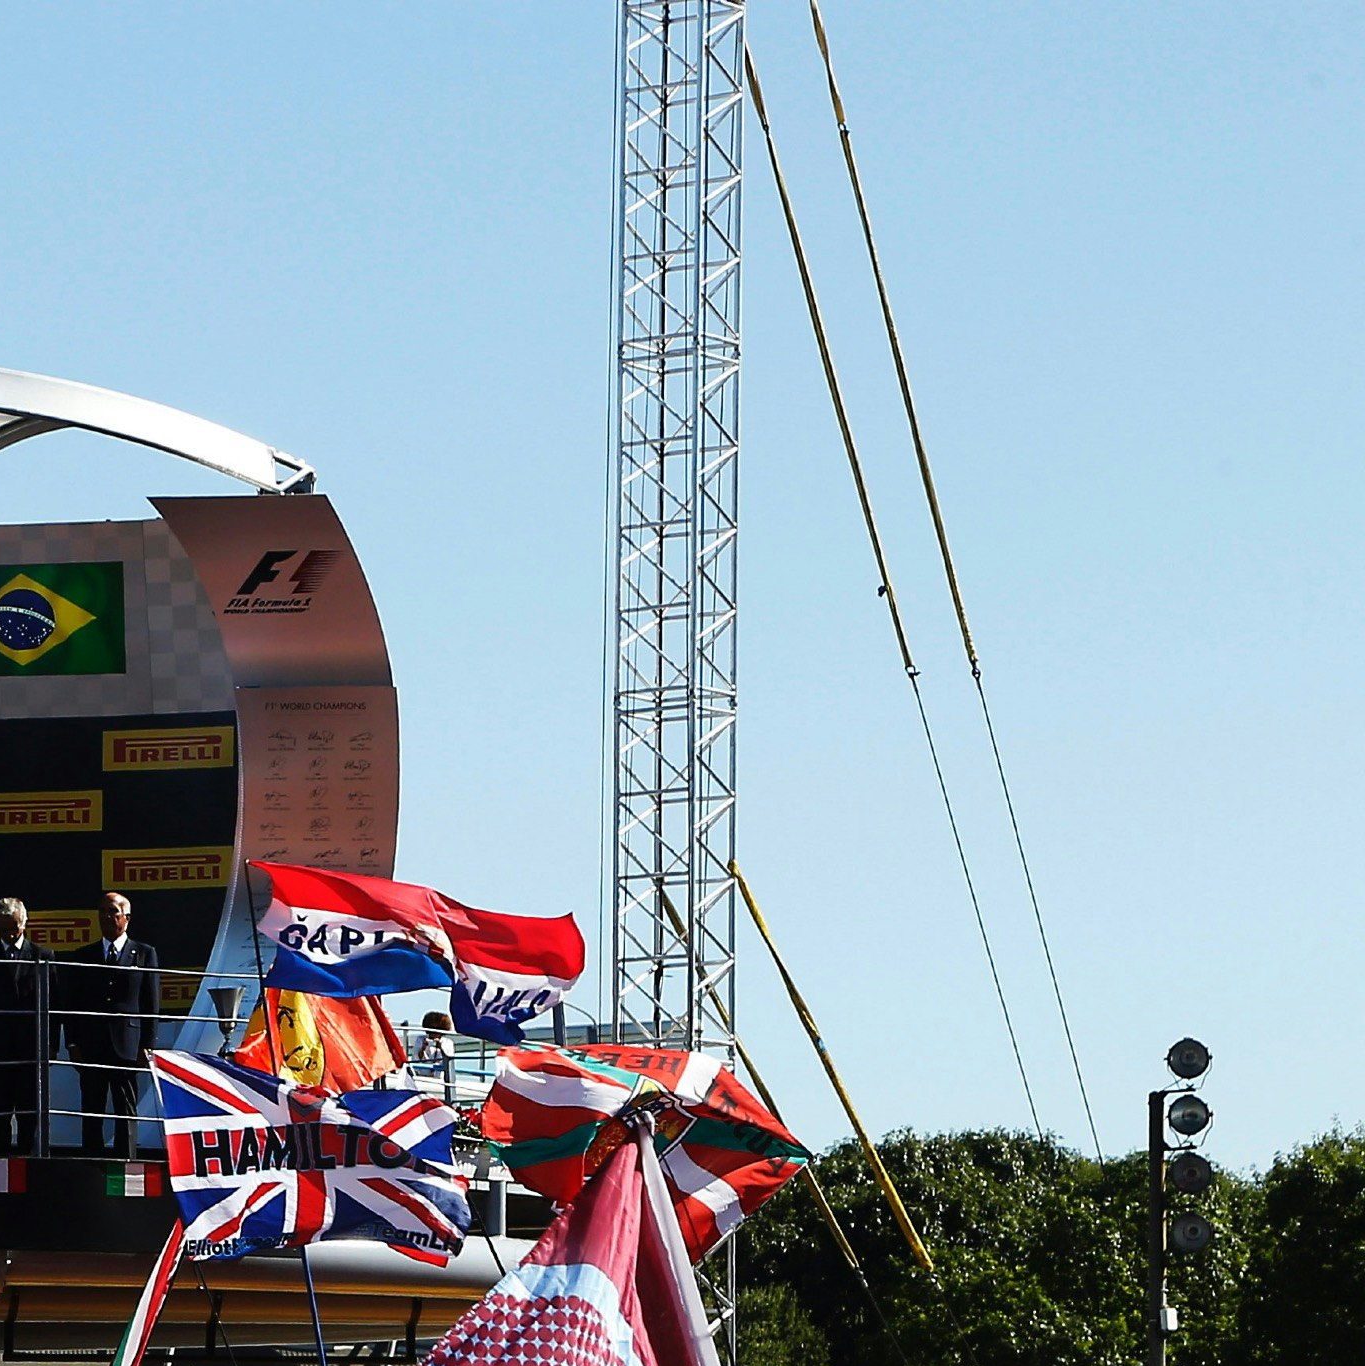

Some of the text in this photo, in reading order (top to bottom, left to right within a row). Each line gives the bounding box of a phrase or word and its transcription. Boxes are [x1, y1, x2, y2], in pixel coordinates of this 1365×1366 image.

[251, 598, 300, 607] Formula
[280, 702, 311, 710] WORLD
[313, 702, 366, 710] CHAMPIONS
[113, 735, 222, 763] PIRELLI
[112, 854, 222, 882] PIRELLI
